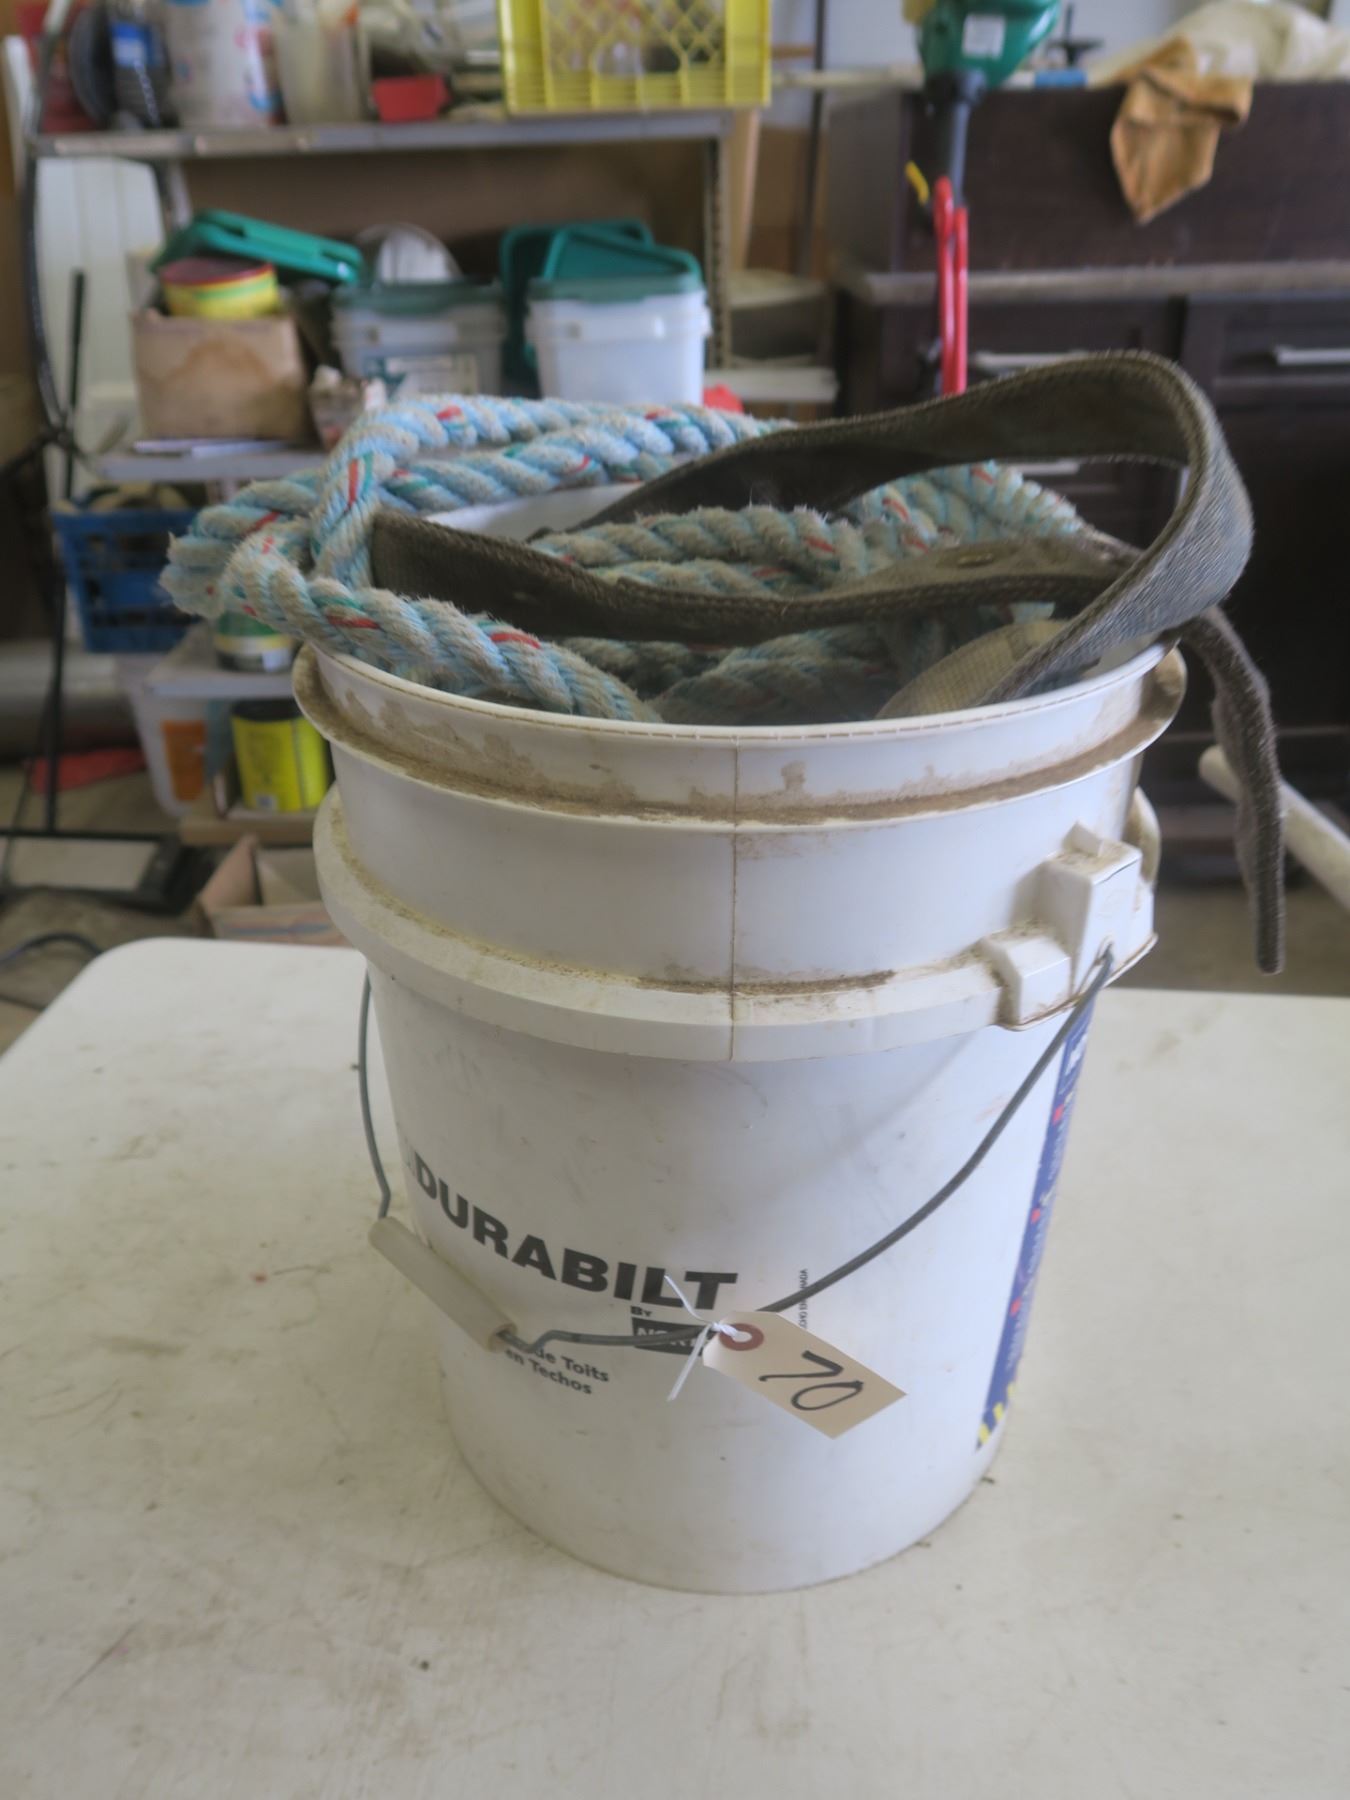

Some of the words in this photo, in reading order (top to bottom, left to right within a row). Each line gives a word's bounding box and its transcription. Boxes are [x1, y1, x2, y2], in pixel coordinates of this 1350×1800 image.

[414, 1150, 738, 1310] DURABILT
[504, 1349, 525, 1366] en
[527, 1358, 592, 1394] Techos
[561, 1355, 609, 1382] Toits
[758, 1350, 864, 1411] 70
